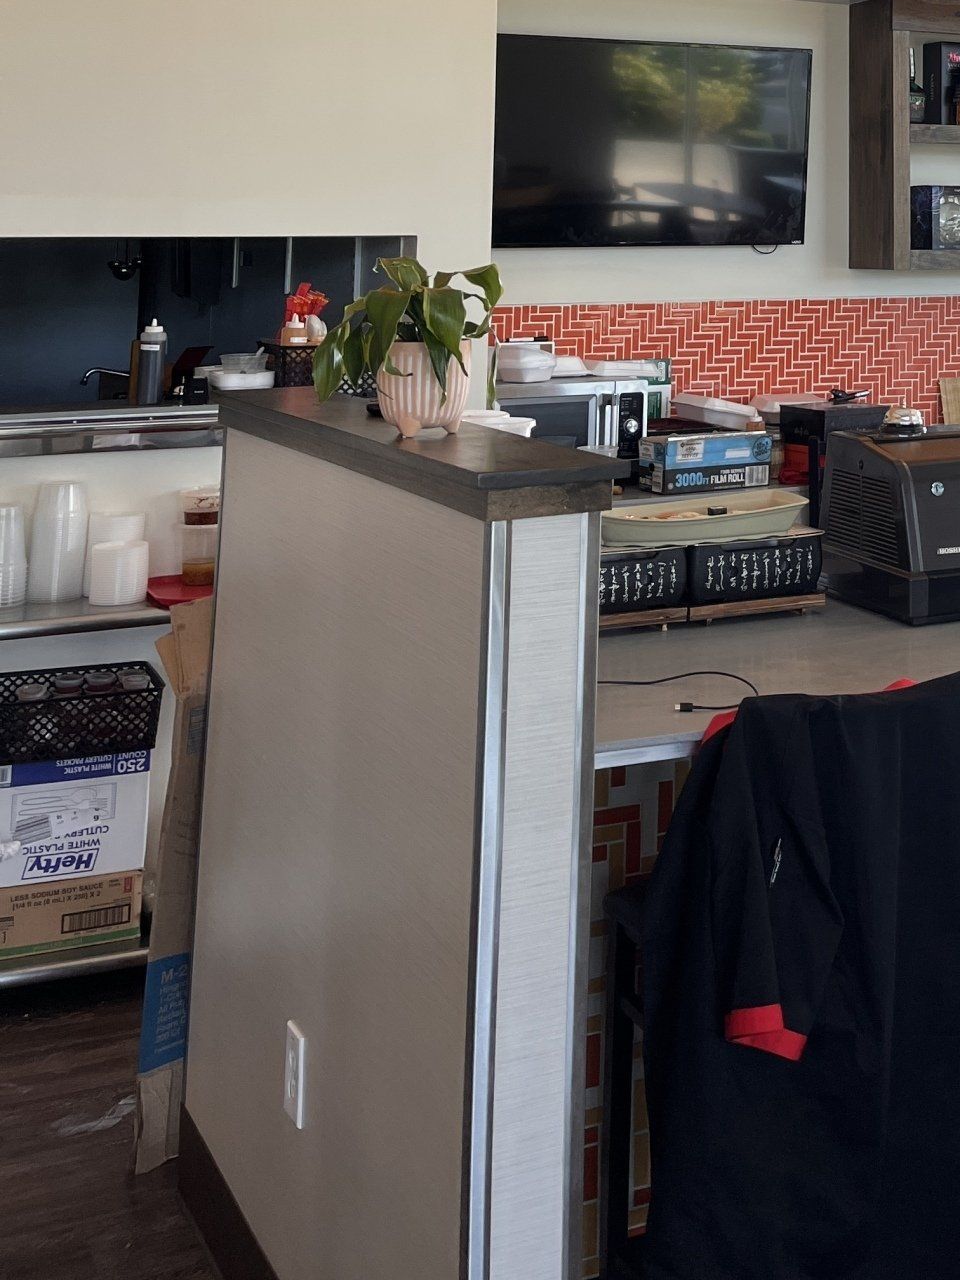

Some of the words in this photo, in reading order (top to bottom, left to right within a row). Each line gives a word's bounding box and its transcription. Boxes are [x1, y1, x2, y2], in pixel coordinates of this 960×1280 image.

[710, 474, 727, 485] FILM
[727, 472, 745, 483] ROLL
[118, 750, 147, 760] COUNT
[64, 765, 90, 775] PLASTIC
[91, 763, 112, 771] WHITE
[117, 758, 146, 773] 250
[22, 843, 64, 856] PLASTIC
[68, 838, 100, 851] WHITE
[29, 852, 94, 874] Hefty
[31, 889, 60, 899] SODIUM
[61, 886, 77, 895] SOY
[79, 882, 104, 892] SAUCE
